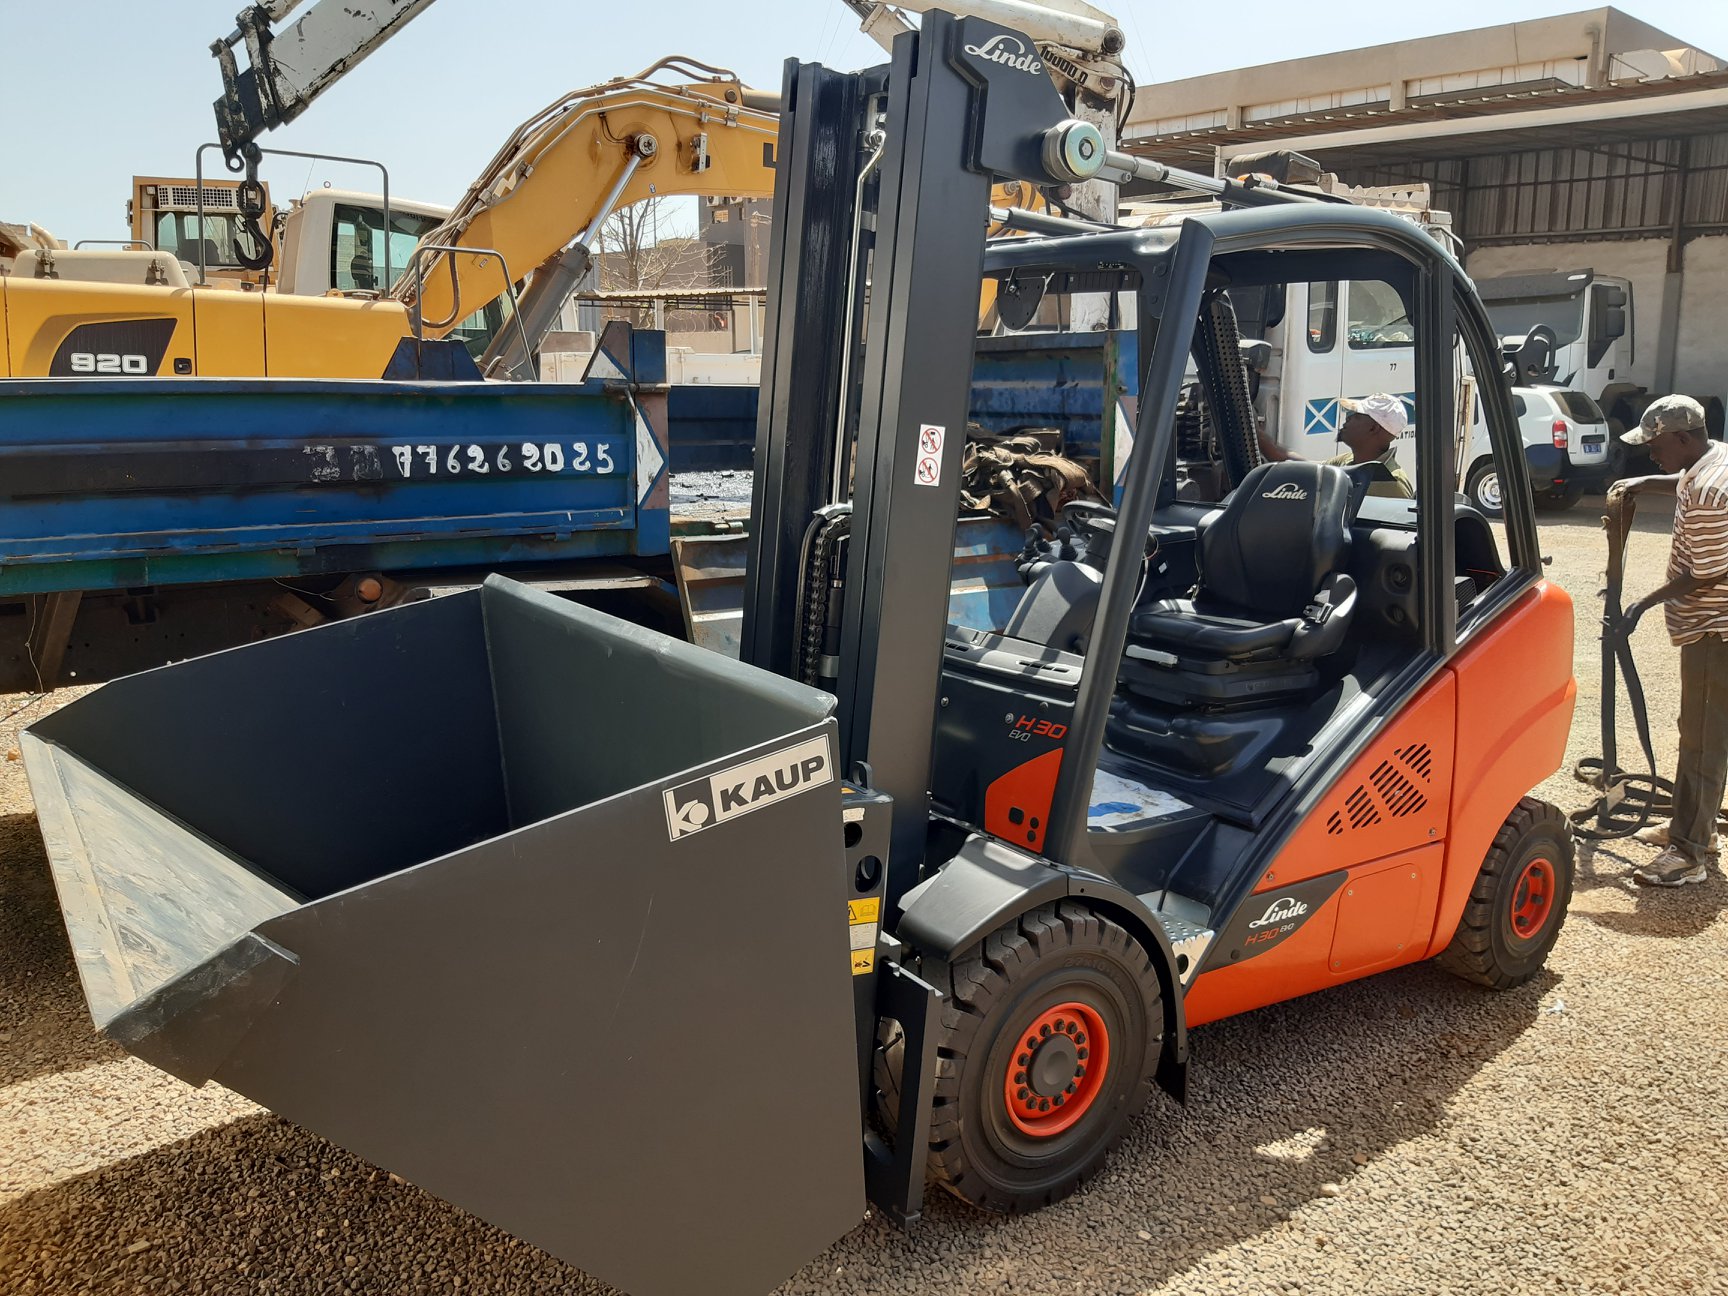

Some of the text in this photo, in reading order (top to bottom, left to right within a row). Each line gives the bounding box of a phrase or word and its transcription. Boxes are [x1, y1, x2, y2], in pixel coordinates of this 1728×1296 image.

[964, 35, 1041, 75] Linde
[70, 352, 148, 374] 920
[1262, 482, 1308, 500] Linde
[1008, 729, 1031, 742] EVO
[720, 755, 825, 813] KAUP
[1248, 897, 1308, 929] Linde
